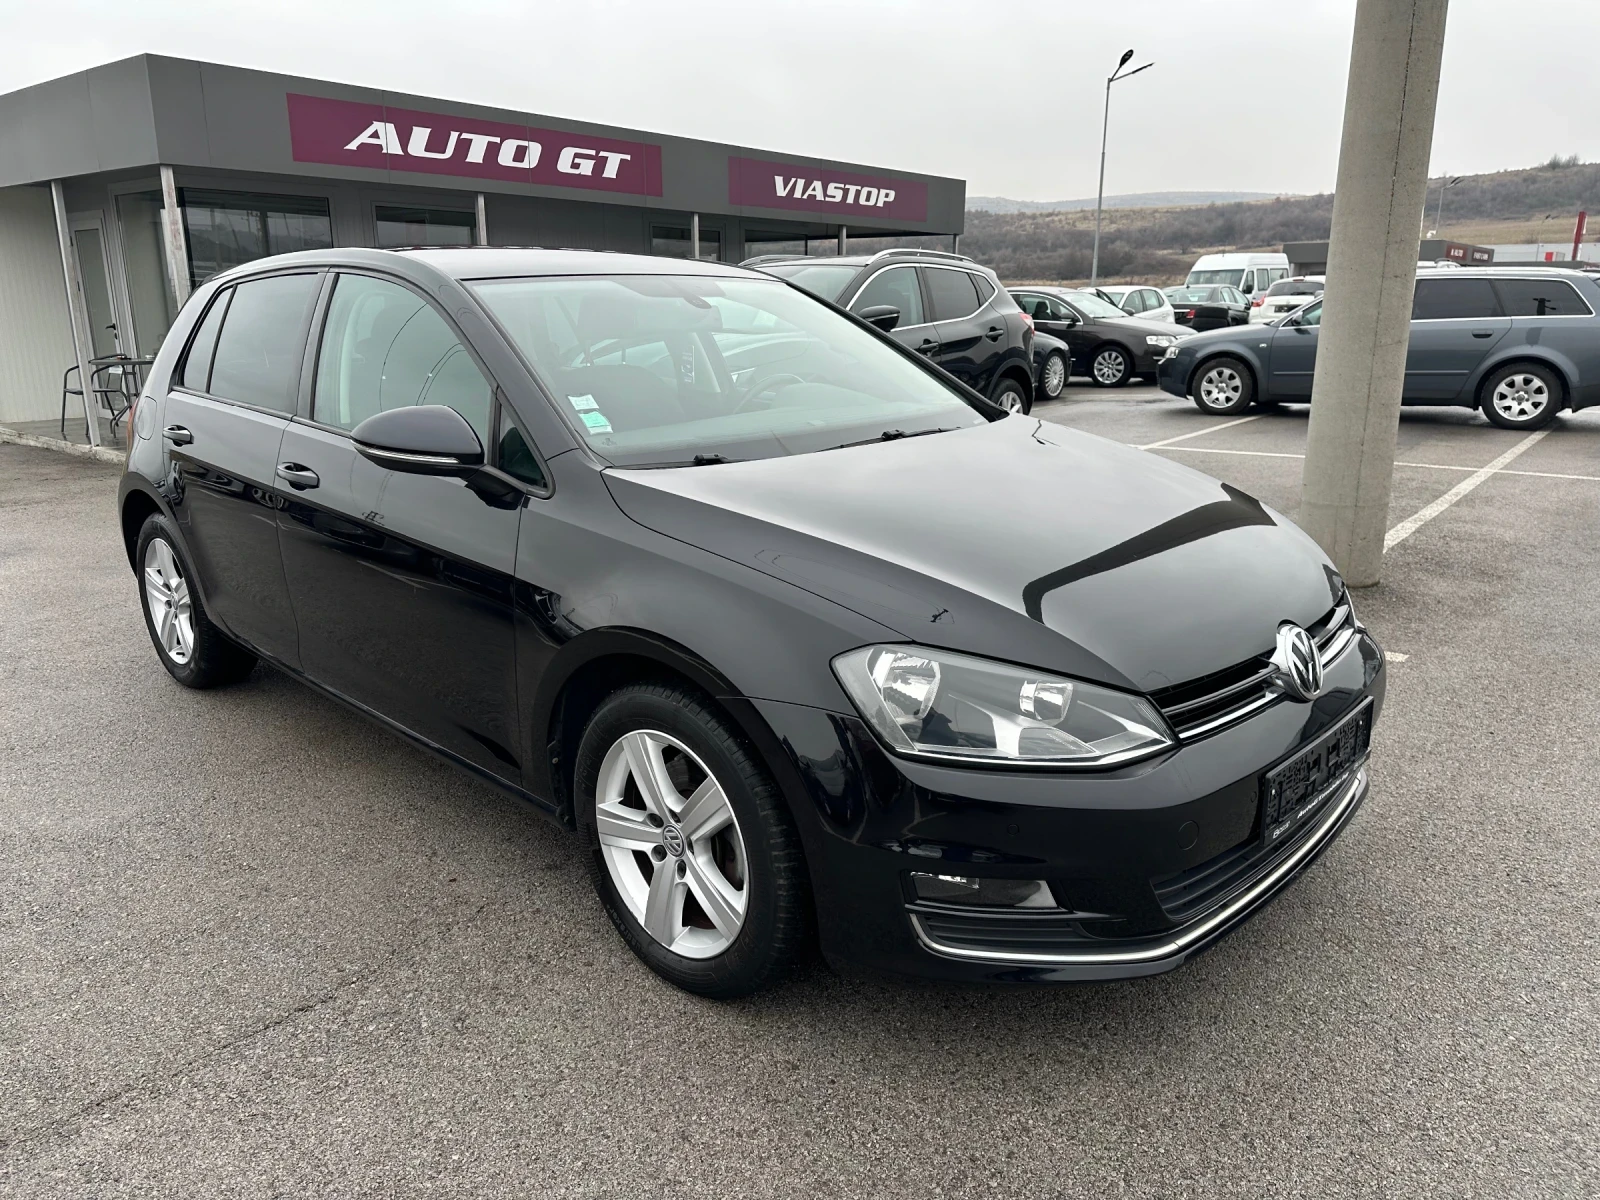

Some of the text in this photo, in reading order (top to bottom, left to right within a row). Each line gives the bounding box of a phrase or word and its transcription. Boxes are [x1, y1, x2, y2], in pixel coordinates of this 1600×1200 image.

[344, 121, 632, 179] AUTO GT
[774, 175, 896, 207] VIASTOP
[1284, 625, 1323, 701] VW
